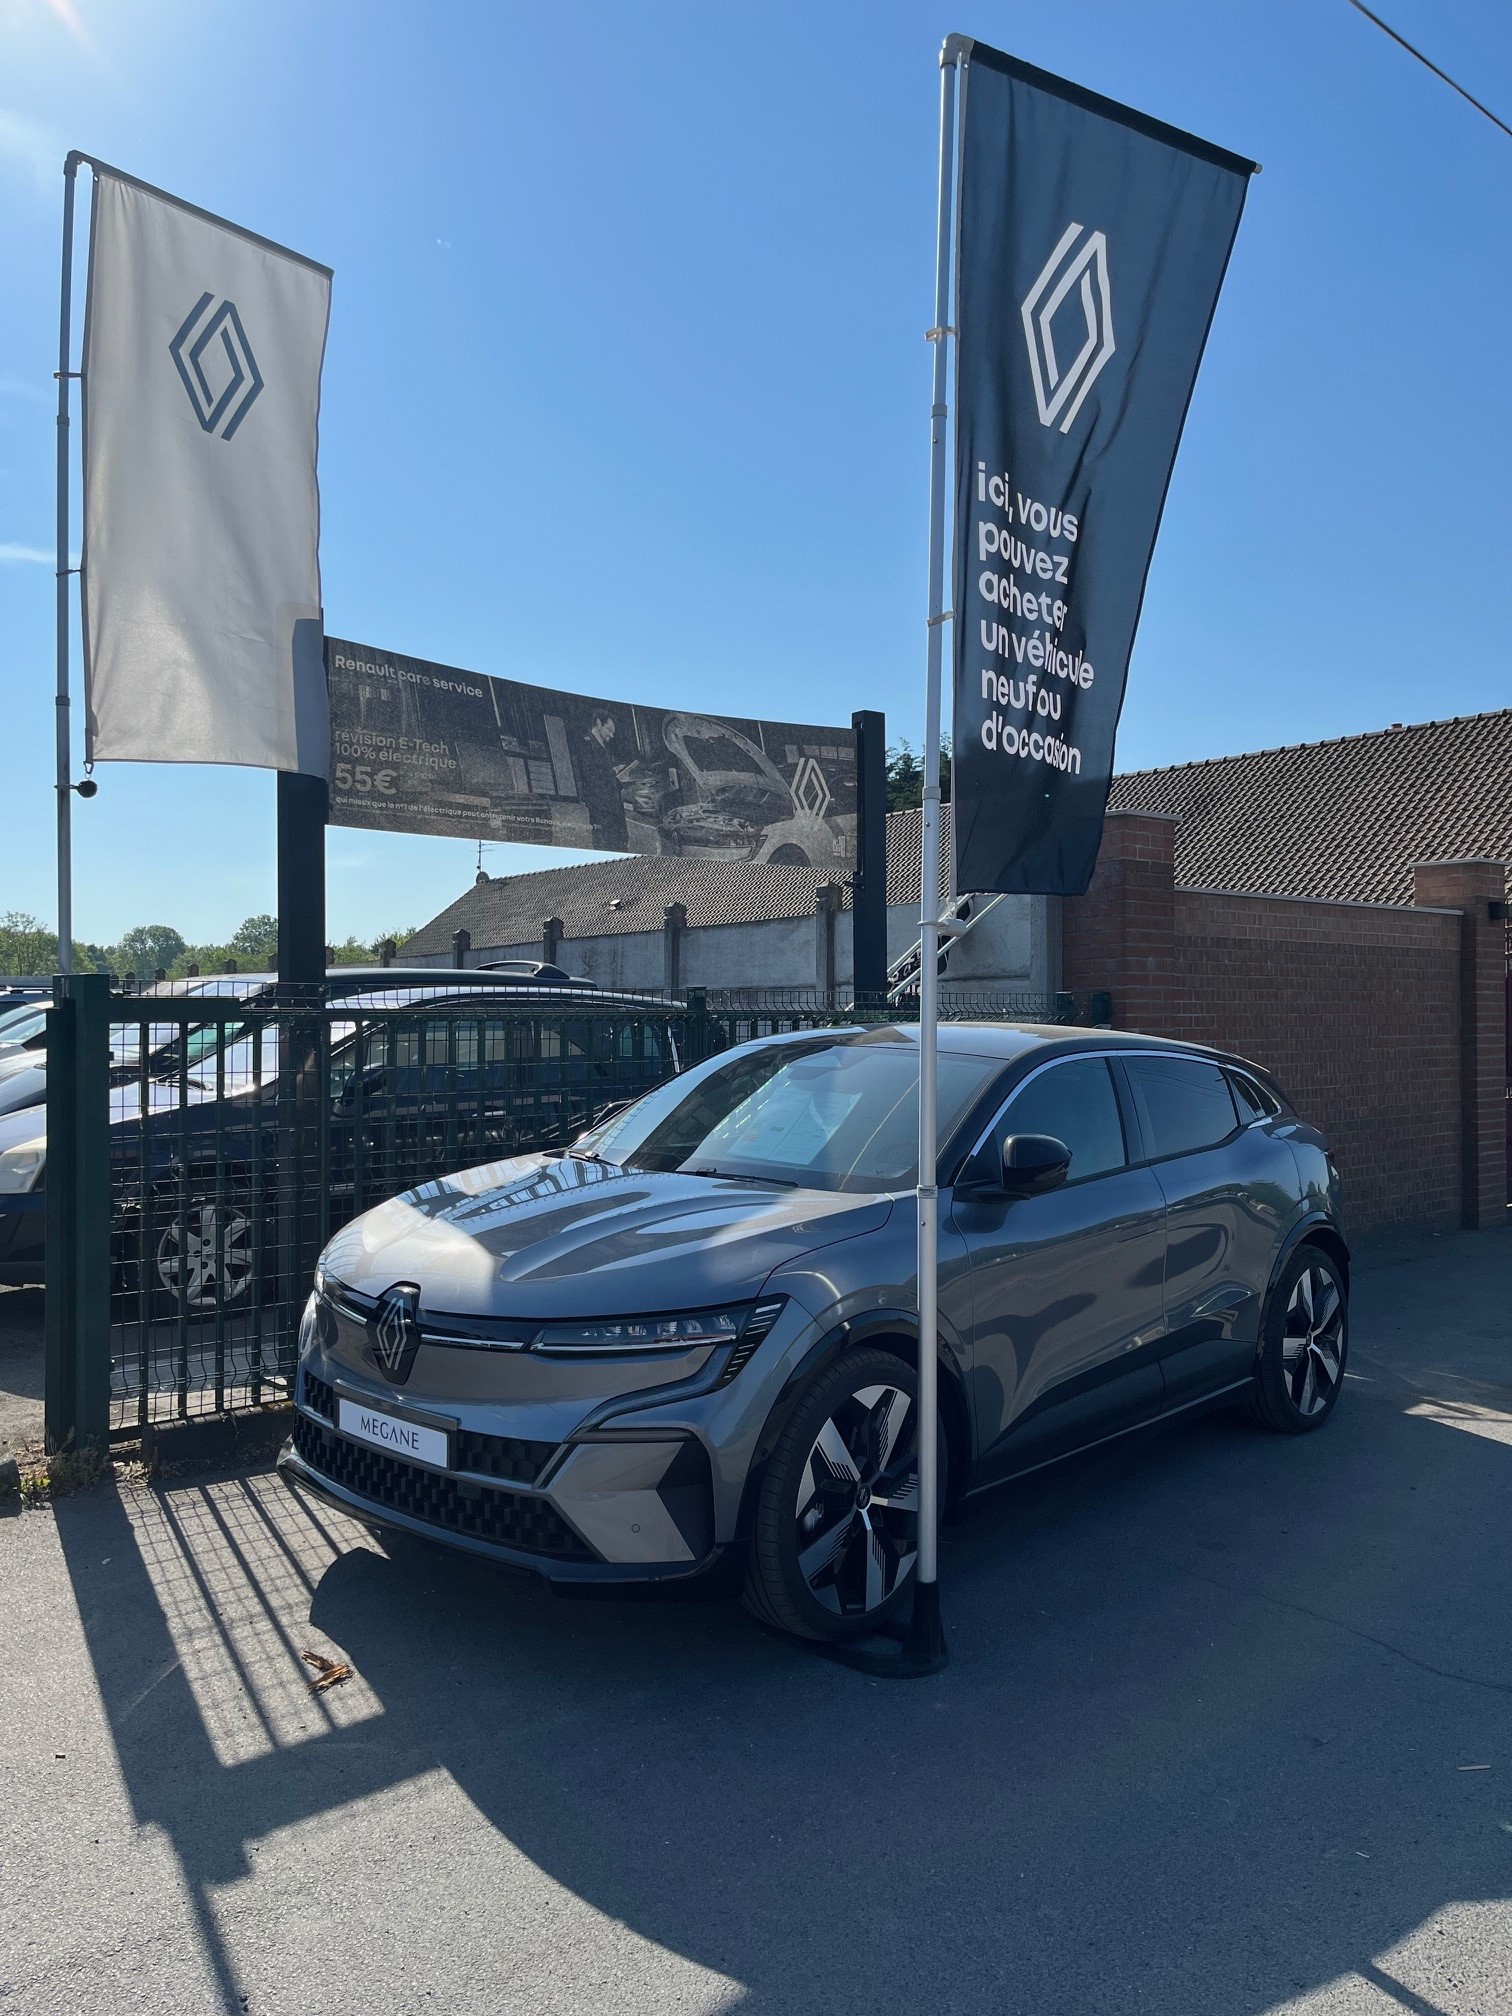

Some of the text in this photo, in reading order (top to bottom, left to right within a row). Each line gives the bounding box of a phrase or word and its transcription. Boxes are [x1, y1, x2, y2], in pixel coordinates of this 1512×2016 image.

[978, 461, 1079, 543] ici, vous
[978, 521, 1069, 585] pouvez
[978, 570, 1068, 632] acheter
[335, 655, 484, 698] Renault care service
[980, 619, 1095, 690] un véhicule
[981, 669, 1062, 721] neuf ou
[335, 728, 450, 755] révision E-Tech
[335, 742, 457, 771] 100% électrique
[981, 711, 1081, 775] d'occasion
[335, 762, 398, 795] 55€
[335, 796, 348, 804] qui
[372, 800, 387, 810] que
[409, 803, 418, 811] de
[516, 815, 535, 823] votre
[360, 1414, 420, 1450] MEGANE
